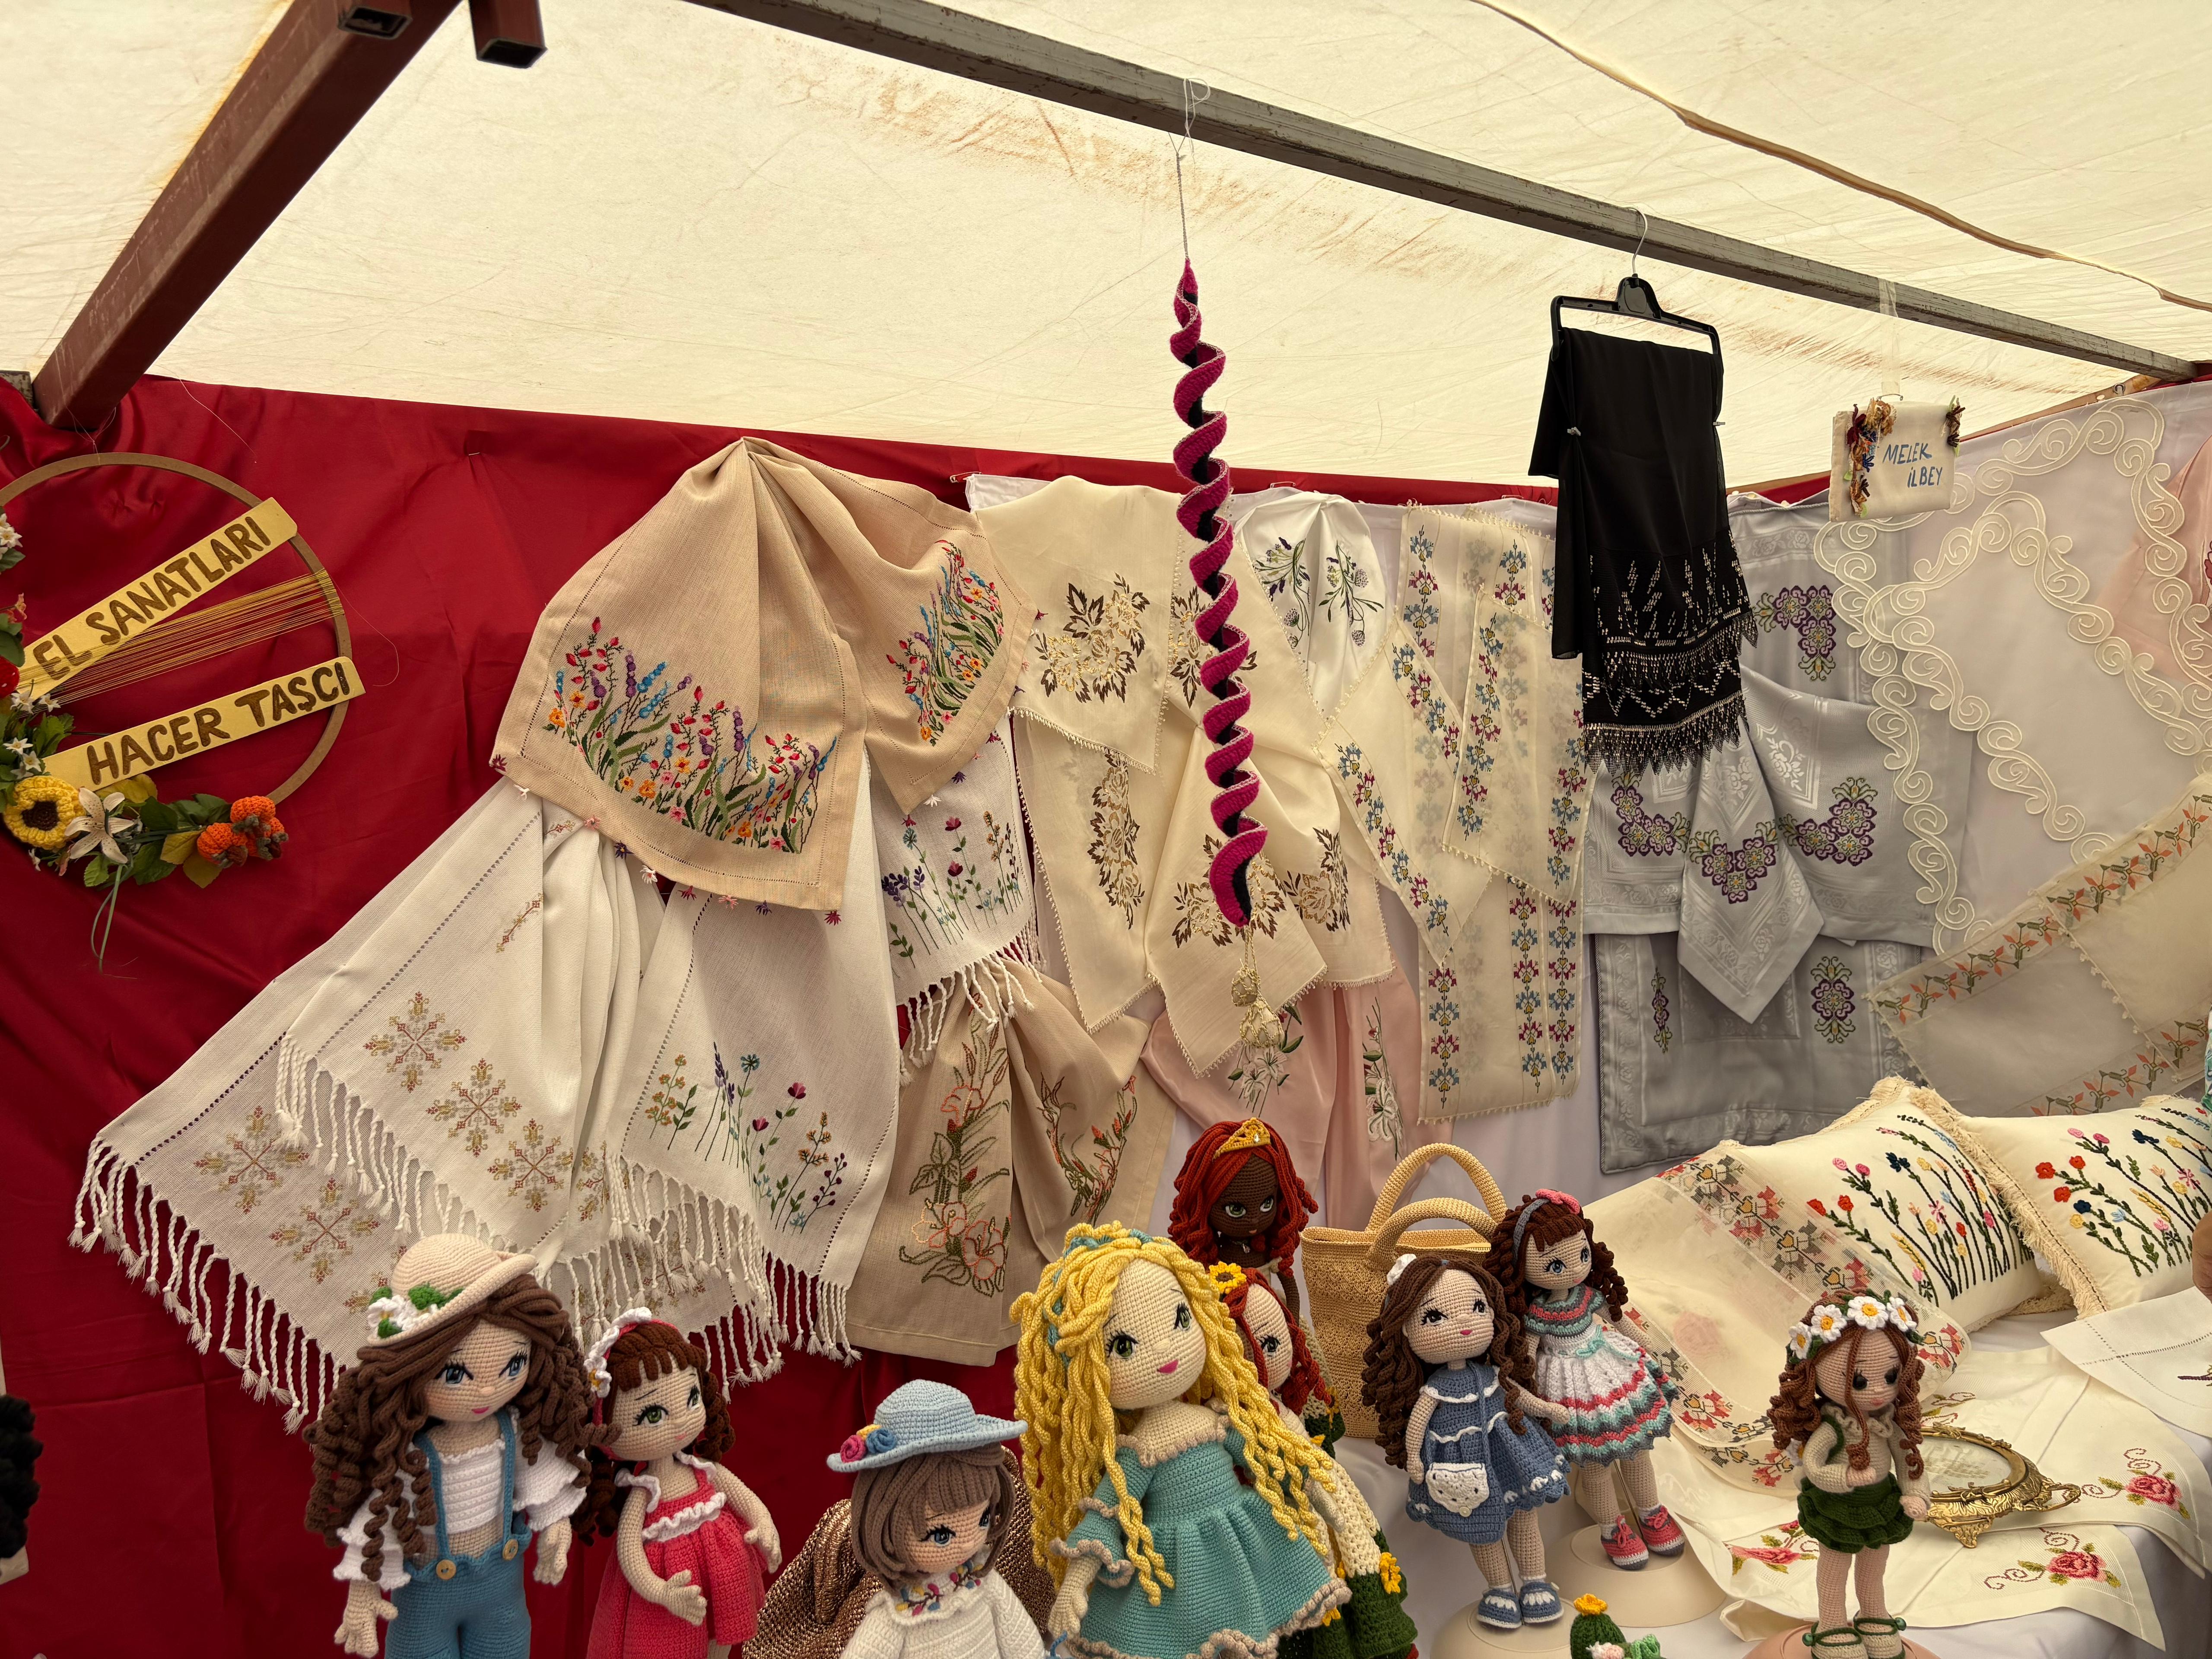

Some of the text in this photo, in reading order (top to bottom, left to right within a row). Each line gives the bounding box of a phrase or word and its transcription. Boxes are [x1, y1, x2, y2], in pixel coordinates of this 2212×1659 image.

[1882, 442, 1932, 464] MELEK
[33, 516, 271, 680] EL SANATLARI
[87, 708, 230, 785] HACER
